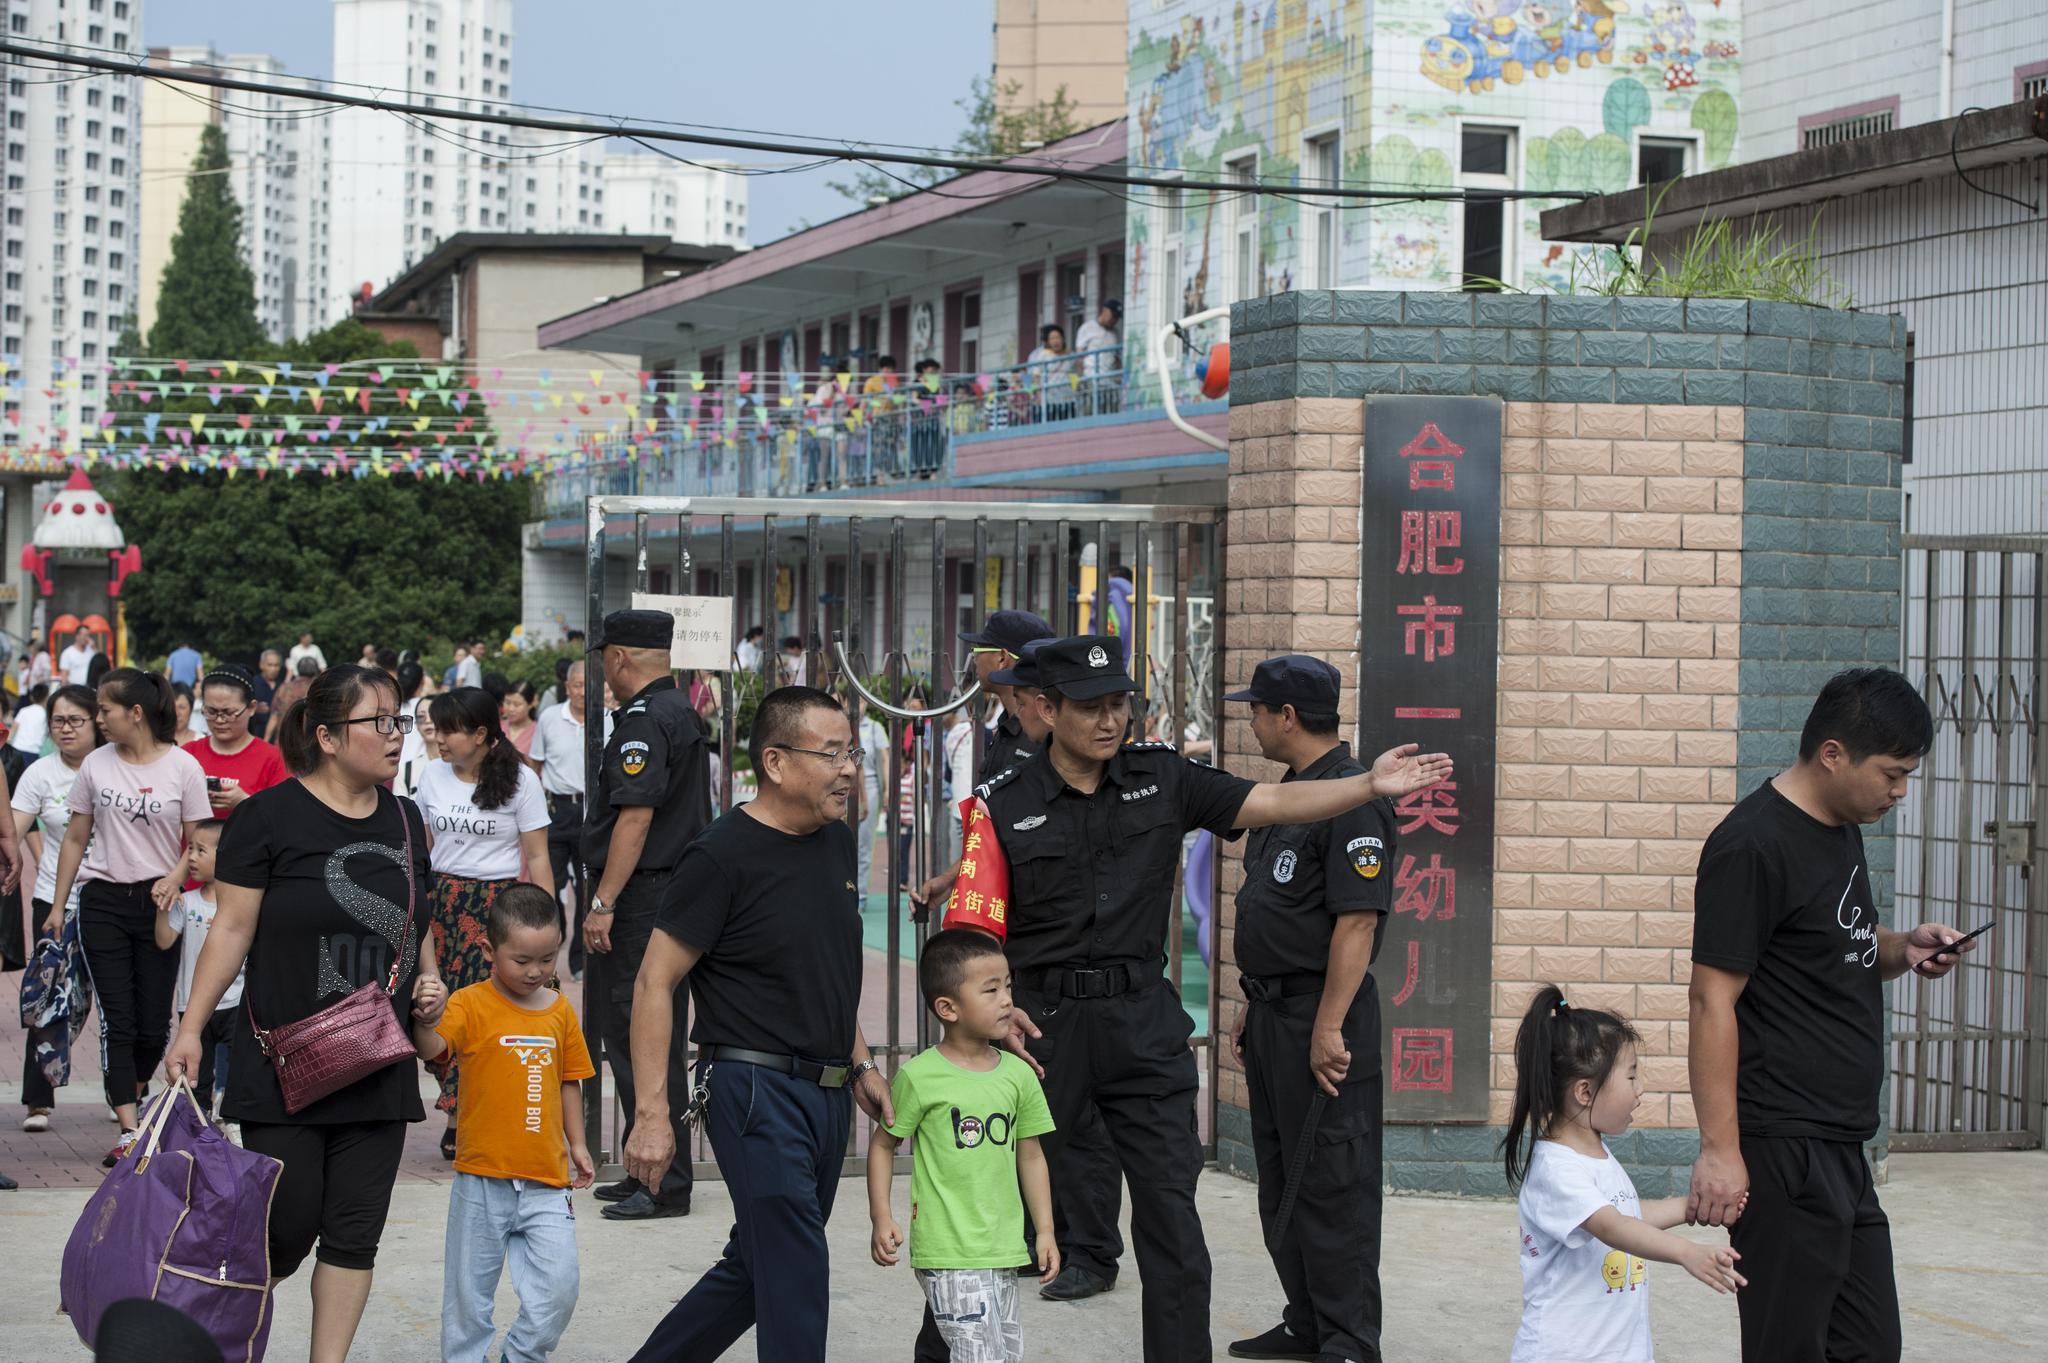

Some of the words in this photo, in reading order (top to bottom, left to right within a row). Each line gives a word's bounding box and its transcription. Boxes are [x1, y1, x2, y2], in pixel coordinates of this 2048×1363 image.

[1121, 784, 1159, 801] 综合执法
[451, 805, 473, 814] THE
[1351, 839, 1380, 849] ZHIAN
[1358, 855, 1378, 866] 治安
[514, 1048, 553, 1066] Y-3
[528, 1065, 543, 1102] HOOD
[525, 1107, 541, 1133] BOY
